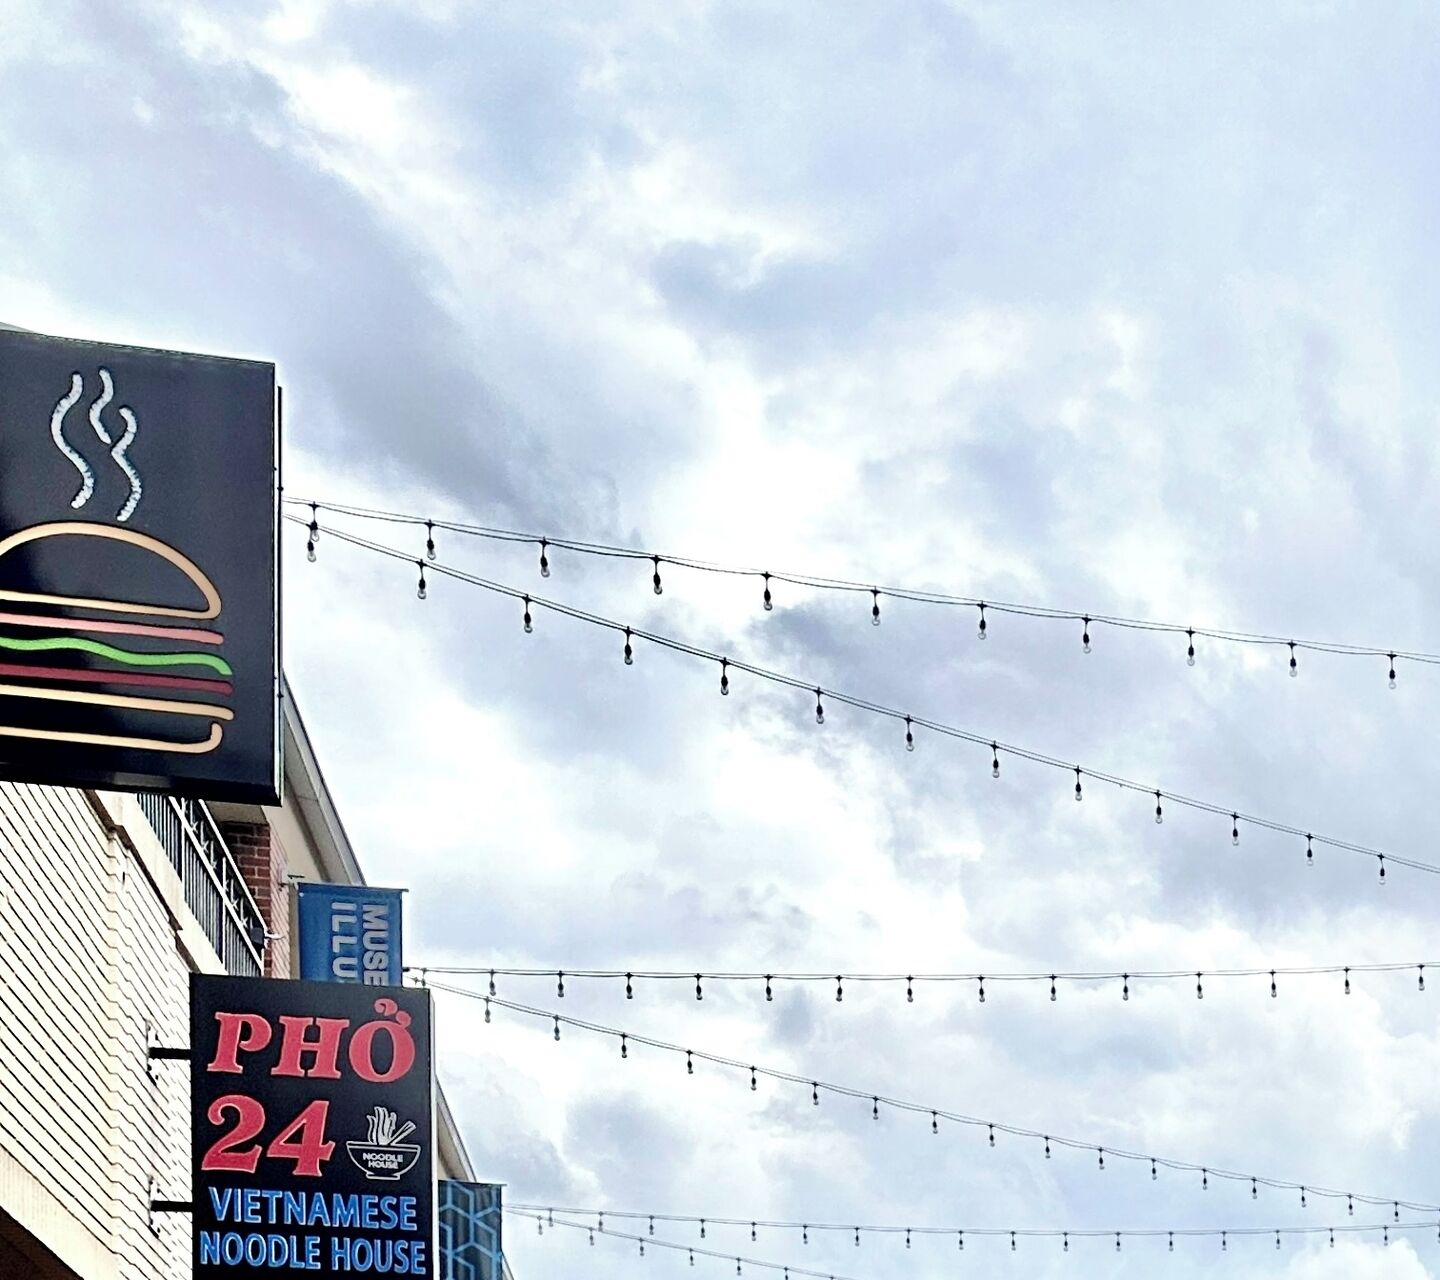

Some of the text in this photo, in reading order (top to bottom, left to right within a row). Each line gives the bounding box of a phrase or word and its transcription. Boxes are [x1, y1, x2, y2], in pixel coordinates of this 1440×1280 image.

[331, 902, 358, 980] ILLU
[206, 998, 416, 1083] PHỞ
[201, 1094, 336, 1178] 24
[362, 1152, 404, 1163] NOODLE
[367, 1160, 399, 1170] HOUSE
[208, 1186, 418, 1231] VIETNAMESE
[200, 1230, 427, 1275] NOODLE HOUSE
